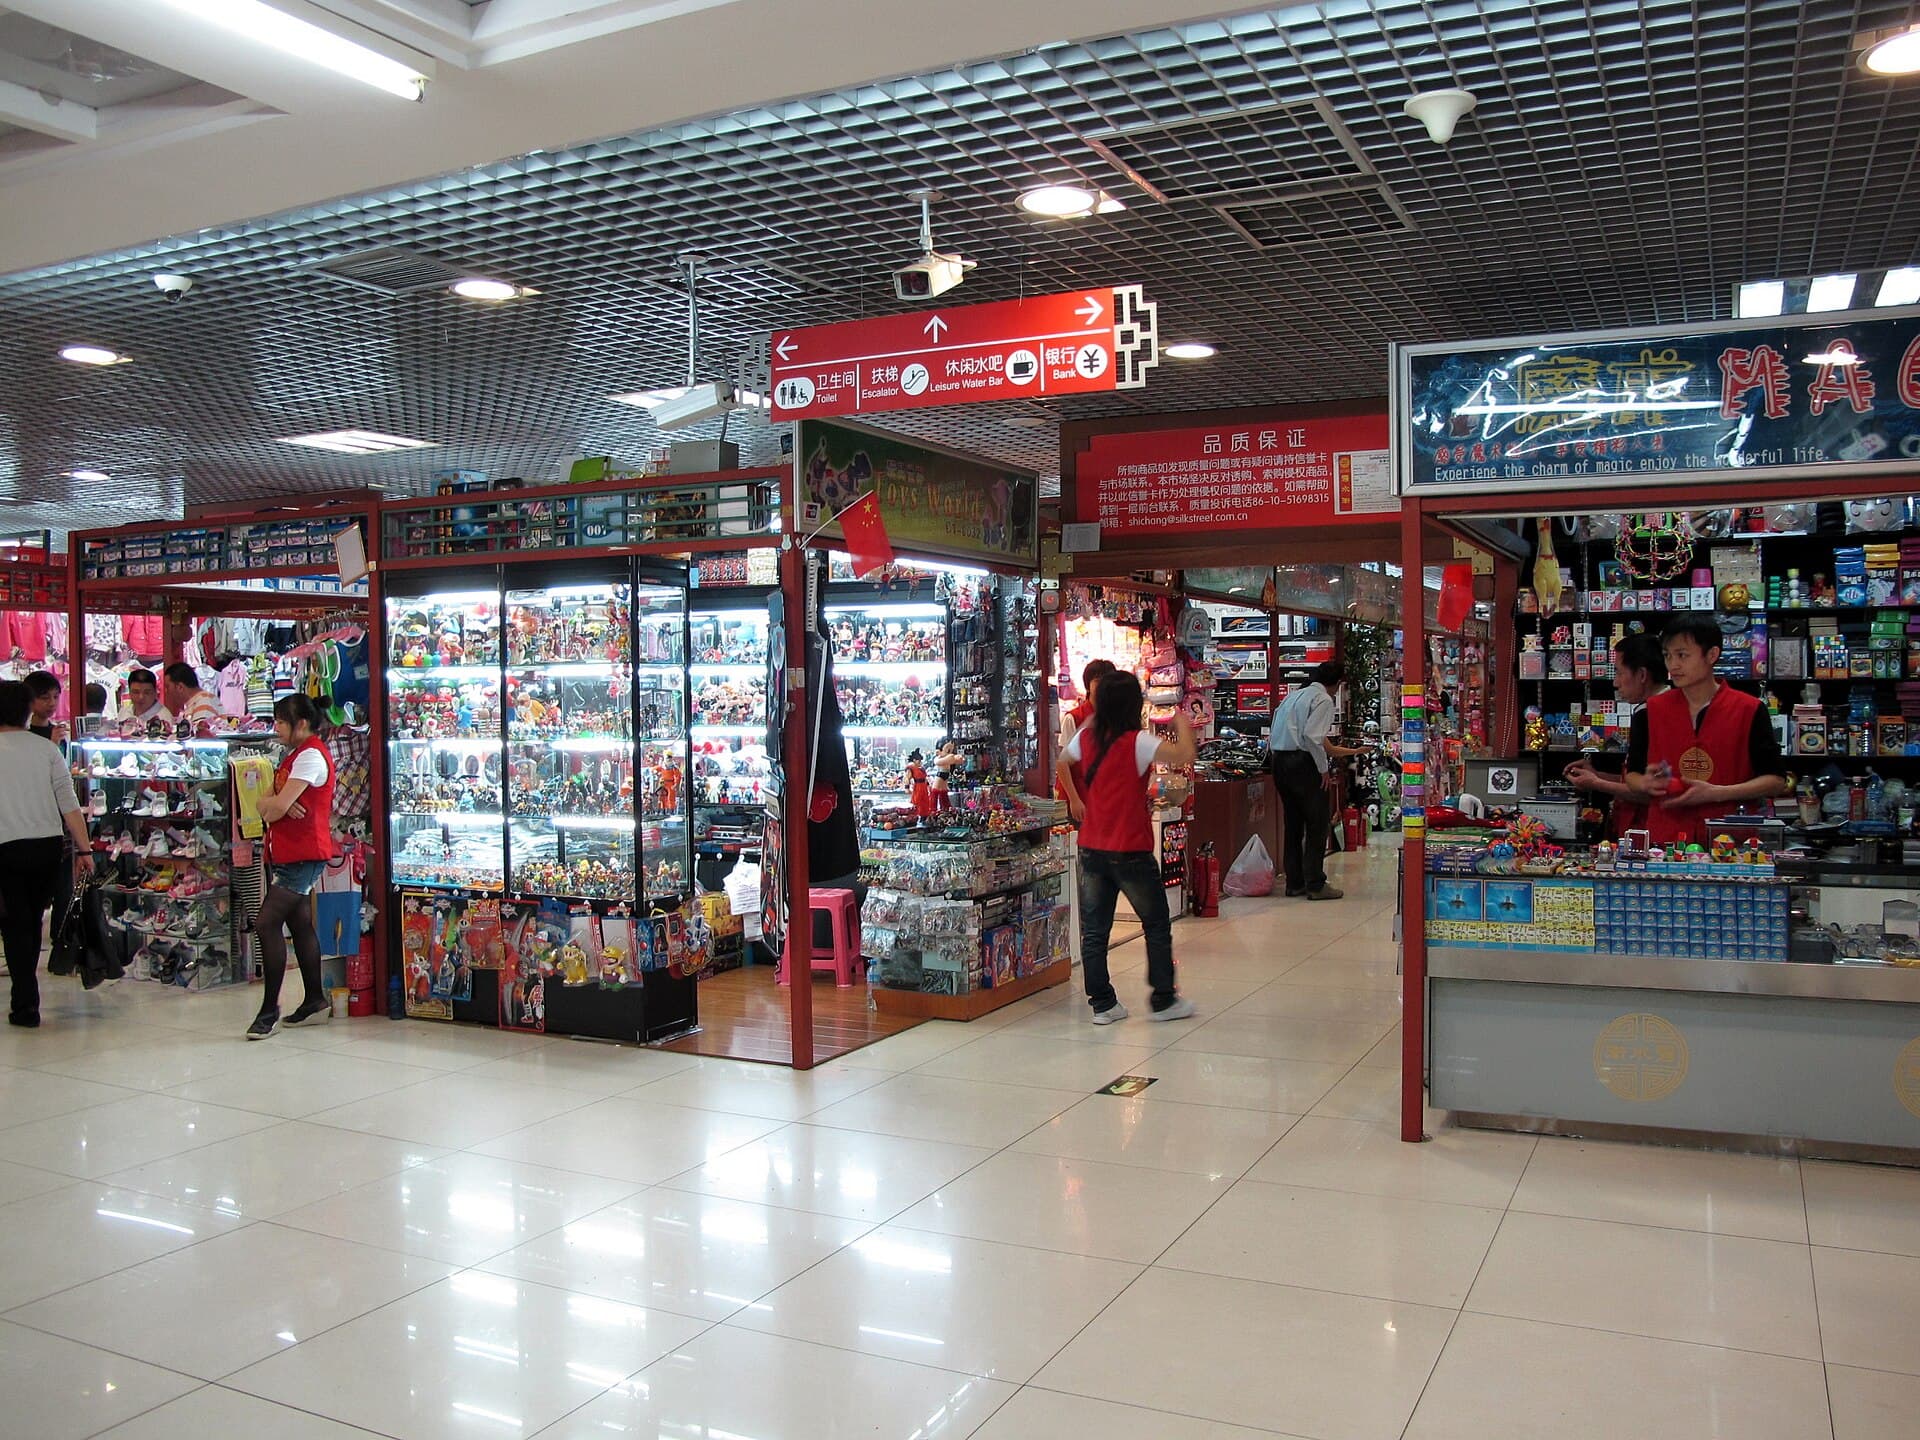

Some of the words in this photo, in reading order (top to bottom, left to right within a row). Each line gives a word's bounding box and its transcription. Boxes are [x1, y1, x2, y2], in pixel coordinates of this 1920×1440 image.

[1045, 346, 1076, 365] 银行
[945, 355, 1003, 376] 休闲水吧
[1052, 368, 1077, 379] Bank
[815, 373, 856, 391] 卫生间
[871, 366, 899, 385] 扶梯
[930, 380, 960, 392] Leisure
[961, 378, 985, 389] Water
[987, 376, 1004, 386] Bar
[816, 393, 838, 404] Toilet
[861, 386, 899, 400] Escalator
[1203, 428, 1307, 454] 品质保证
[1434, 465, 1497, 482] Experiene
[1504, 463, 1524, 477] the
[1531, 461, 1568, 476] charm
[1574, 459, 1589, 474] of
[1595, 457, 1633, 476] magic
[1640, 454, 1678, 473] enjoy
[1685, 453, 1708, 468] the
[1715, 449, 1783, 466] woderful
